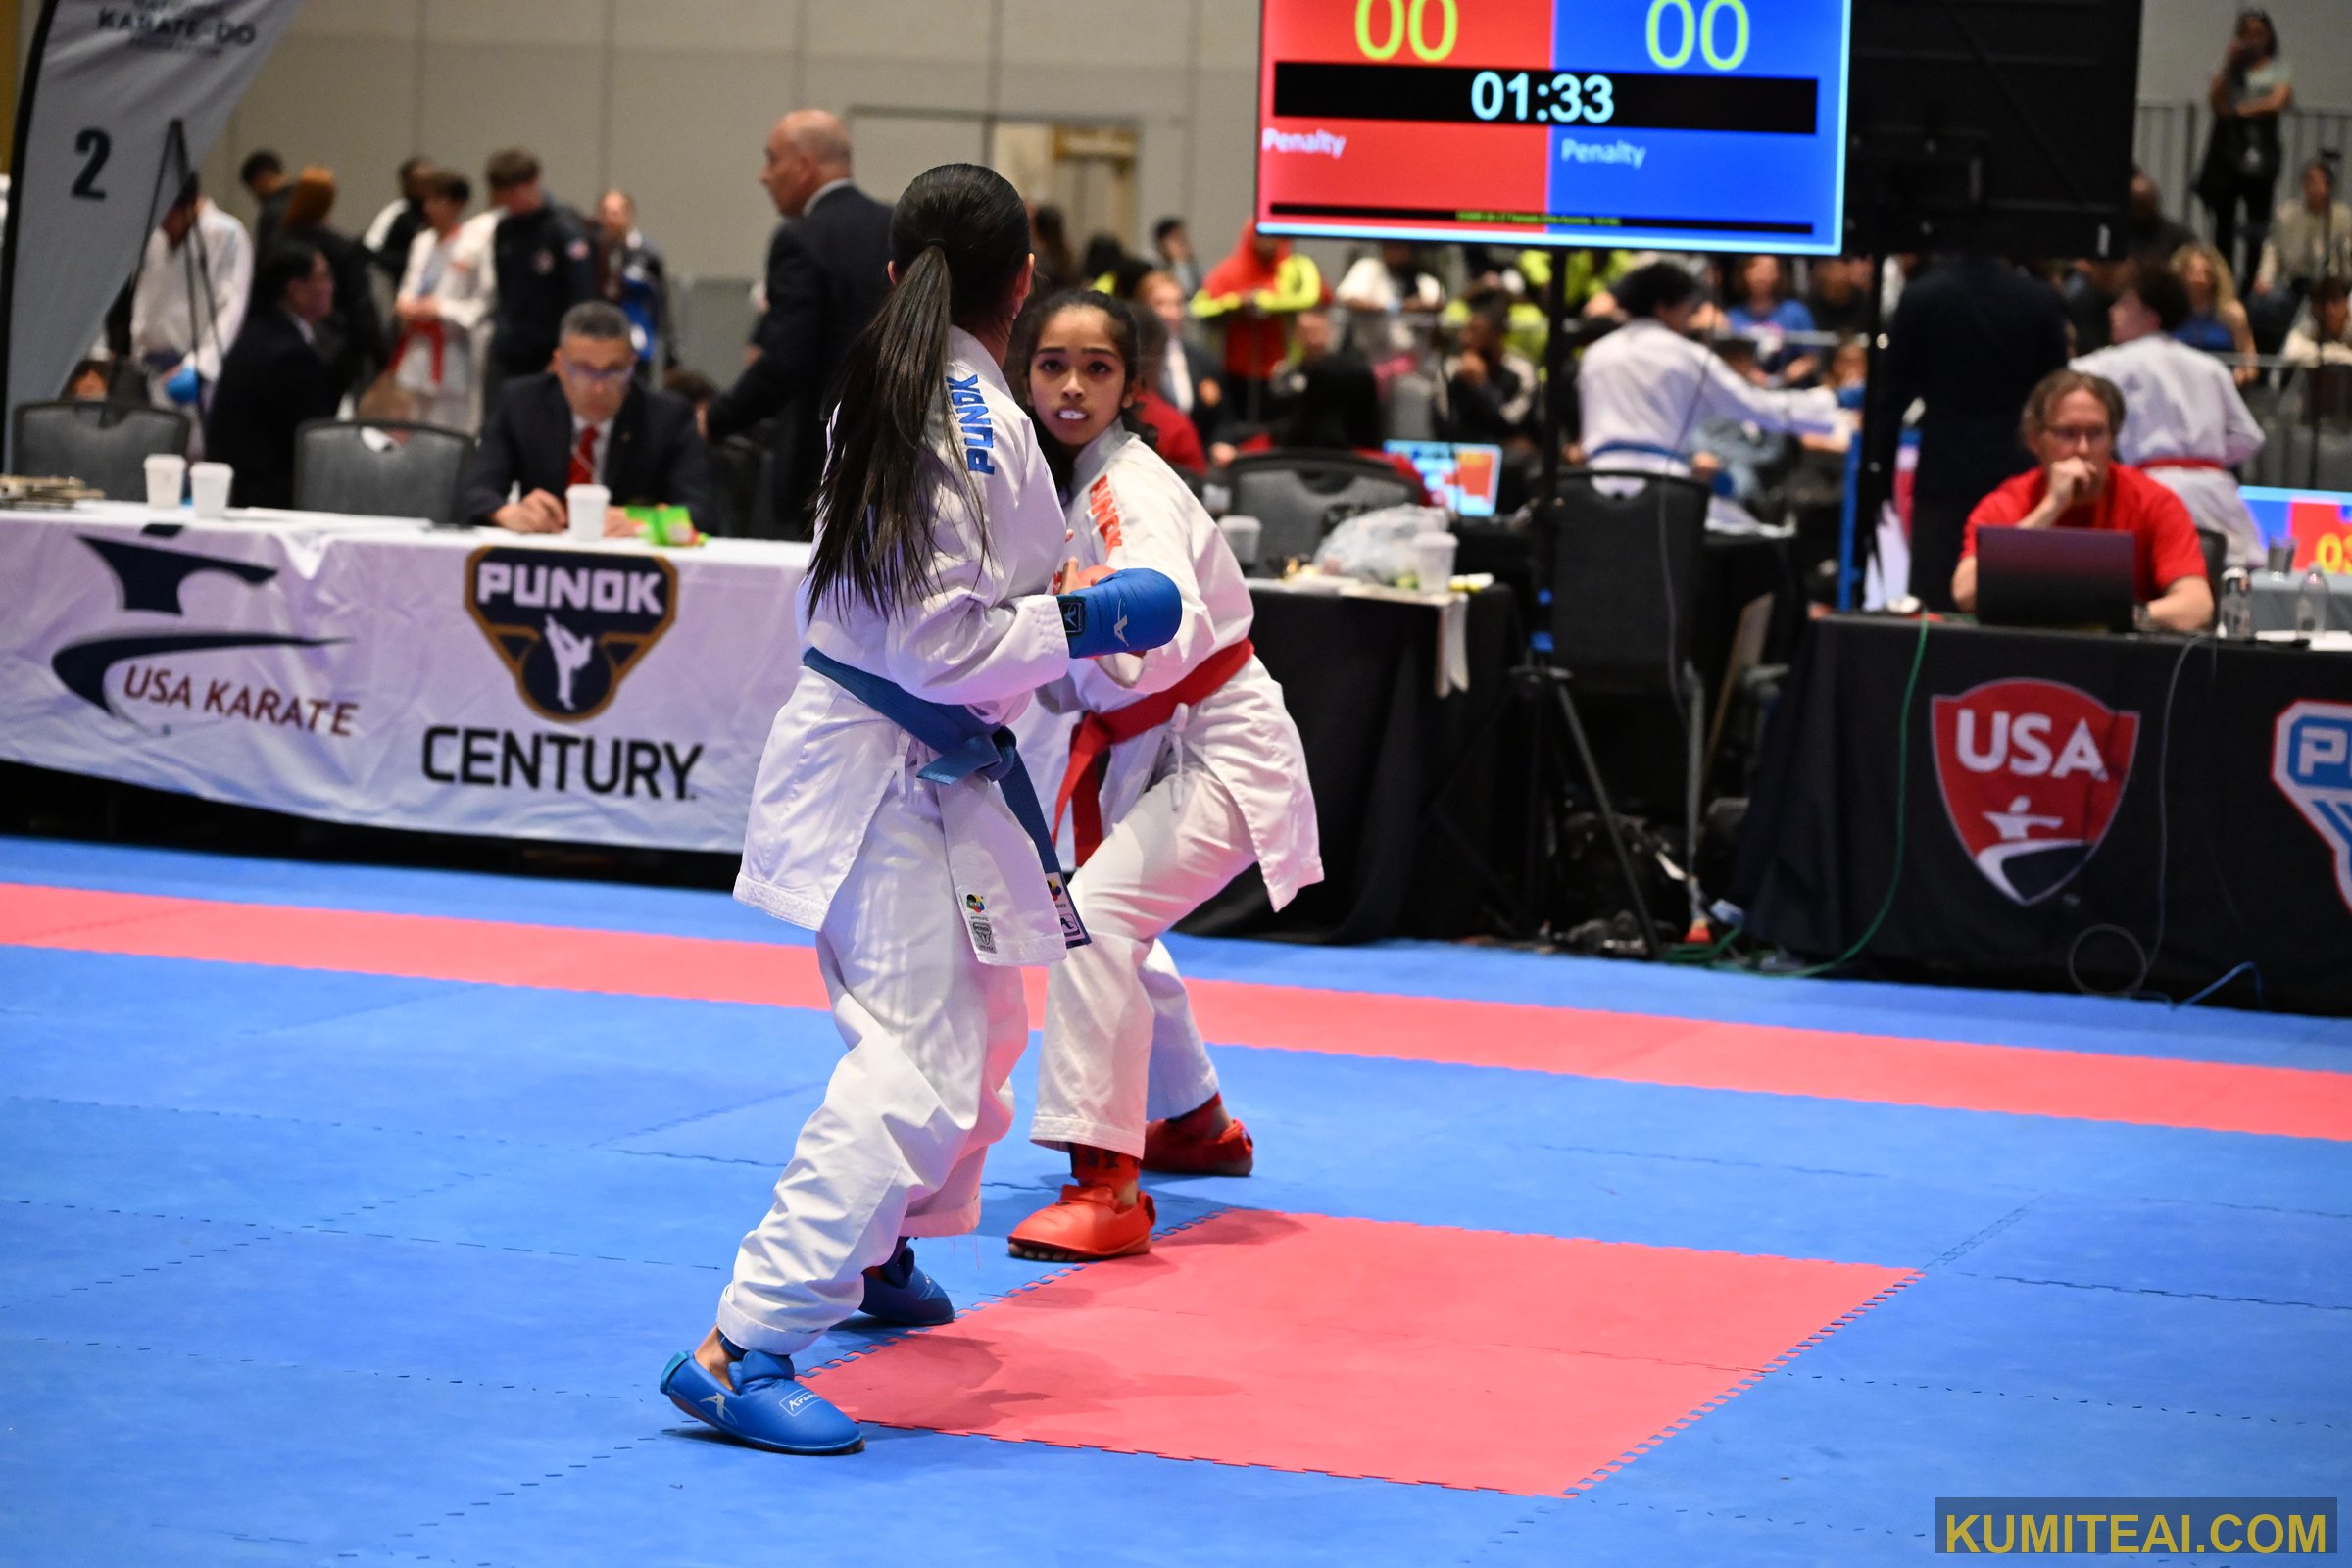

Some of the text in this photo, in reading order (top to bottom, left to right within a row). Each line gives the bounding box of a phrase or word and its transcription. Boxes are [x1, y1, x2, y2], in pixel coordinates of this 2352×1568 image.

[1354, 0, 1458, 61] 00
[1645, 0, 1750, 71] 00
[1471, 71, 1614, 123] 01:33
[73, 129, 111, 199] 2
[1261, 128, 1346, 159] Penalty
[1562, 138, 1646, 169] Penalty
[946, 374, 995, 475] PUNOK
[476, 562, 664, 615] PUNOK
[123, 665, 360, 737] USA KARATE
[422, 725, 704, 801] CENTURY
[1956, 709, 2109, 782] USA
